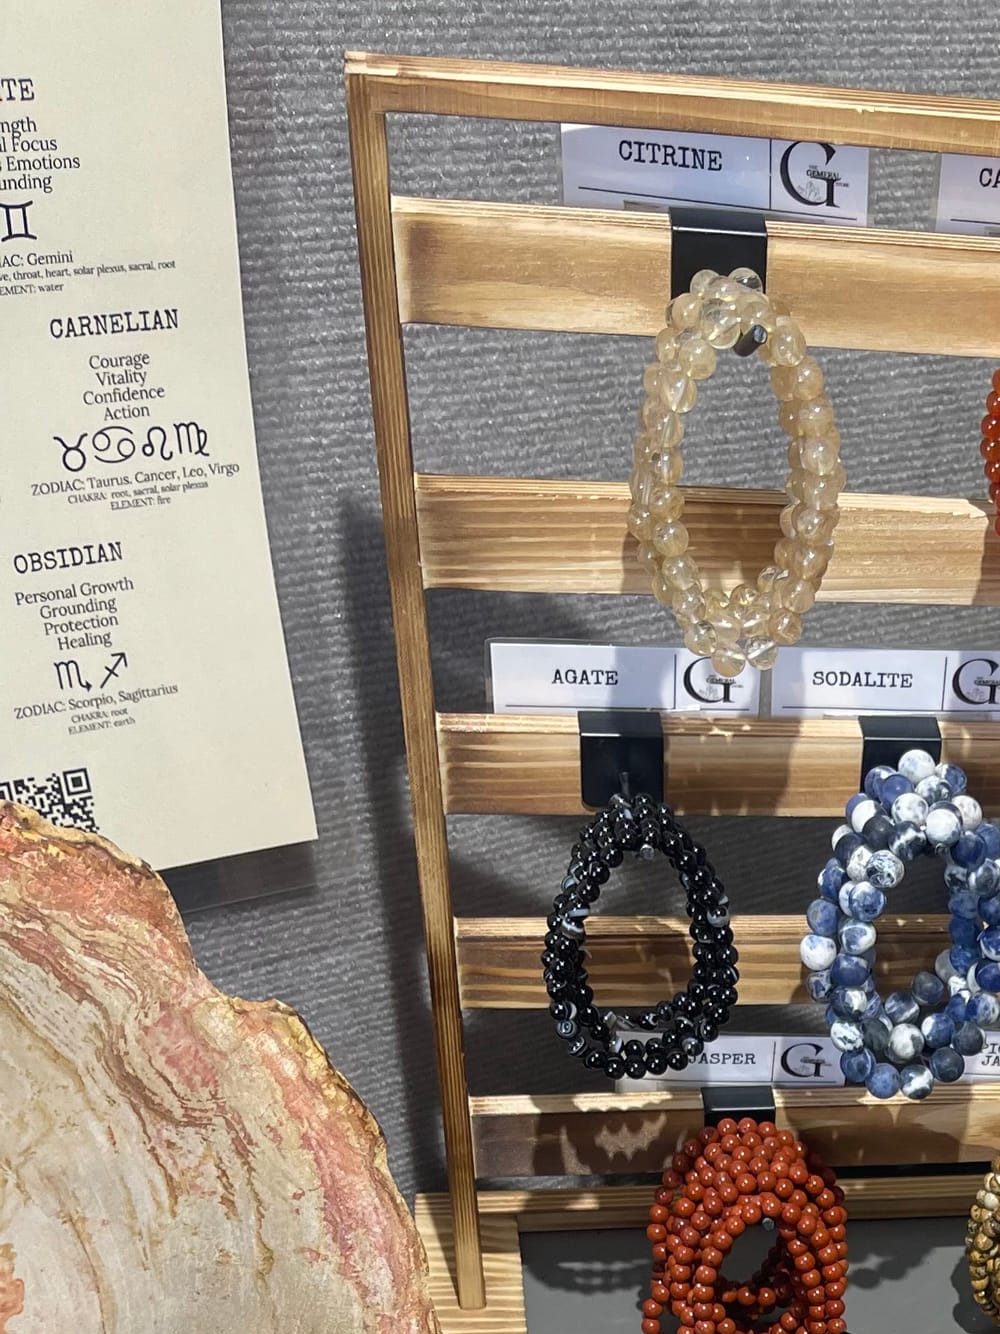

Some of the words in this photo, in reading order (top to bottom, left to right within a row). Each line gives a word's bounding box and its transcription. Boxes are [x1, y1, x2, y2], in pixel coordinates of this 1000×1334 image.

[12, 138, 58, 152] Focus
[6, 154, 81, 171] Emotions
[619, 140, 722, 171] CITRINE
[27, 250, 74, 266] Gemini
[13, 270, 43, 281] throat,
[45, 268, 71, 278] heart,
[73, 266, 95, 276] solar
[158, 260, 176, 269] root
[38, 283, 65, 293] water
[50, 309, 179, 339] CARNELIAN
[89, 353, 150, 370] Courage
[95, 370, 147, 387] Vitality
[83, 386, 165, 405] Confidence
[103, 405, 151, 421] Action
[31, 479, 85, 496] ZODIAC:
[134, 469, 180, 484] Cancer,
[182, 466, 207, 479] Leo,
[208, 462, 240, 478] Virgo
[14, 542, 123, 574] OBSIDIAN
[15, 584, 77, 605] Personal
[80, 576, 135, 597] Growth
[40, 598, 118, 619] Grounding
[44, 615, 119, 635] Protection
[57, 632, 112, 650] Healing
[552, 669, 618, 685] AGATE
[812, 671, 913, 688] SODALITE
[14, 701, 66, 720] ZODIAC:
[68, 693, 116, 711] Scorpio,
[118, 684, 178, 703] Sagittarius
